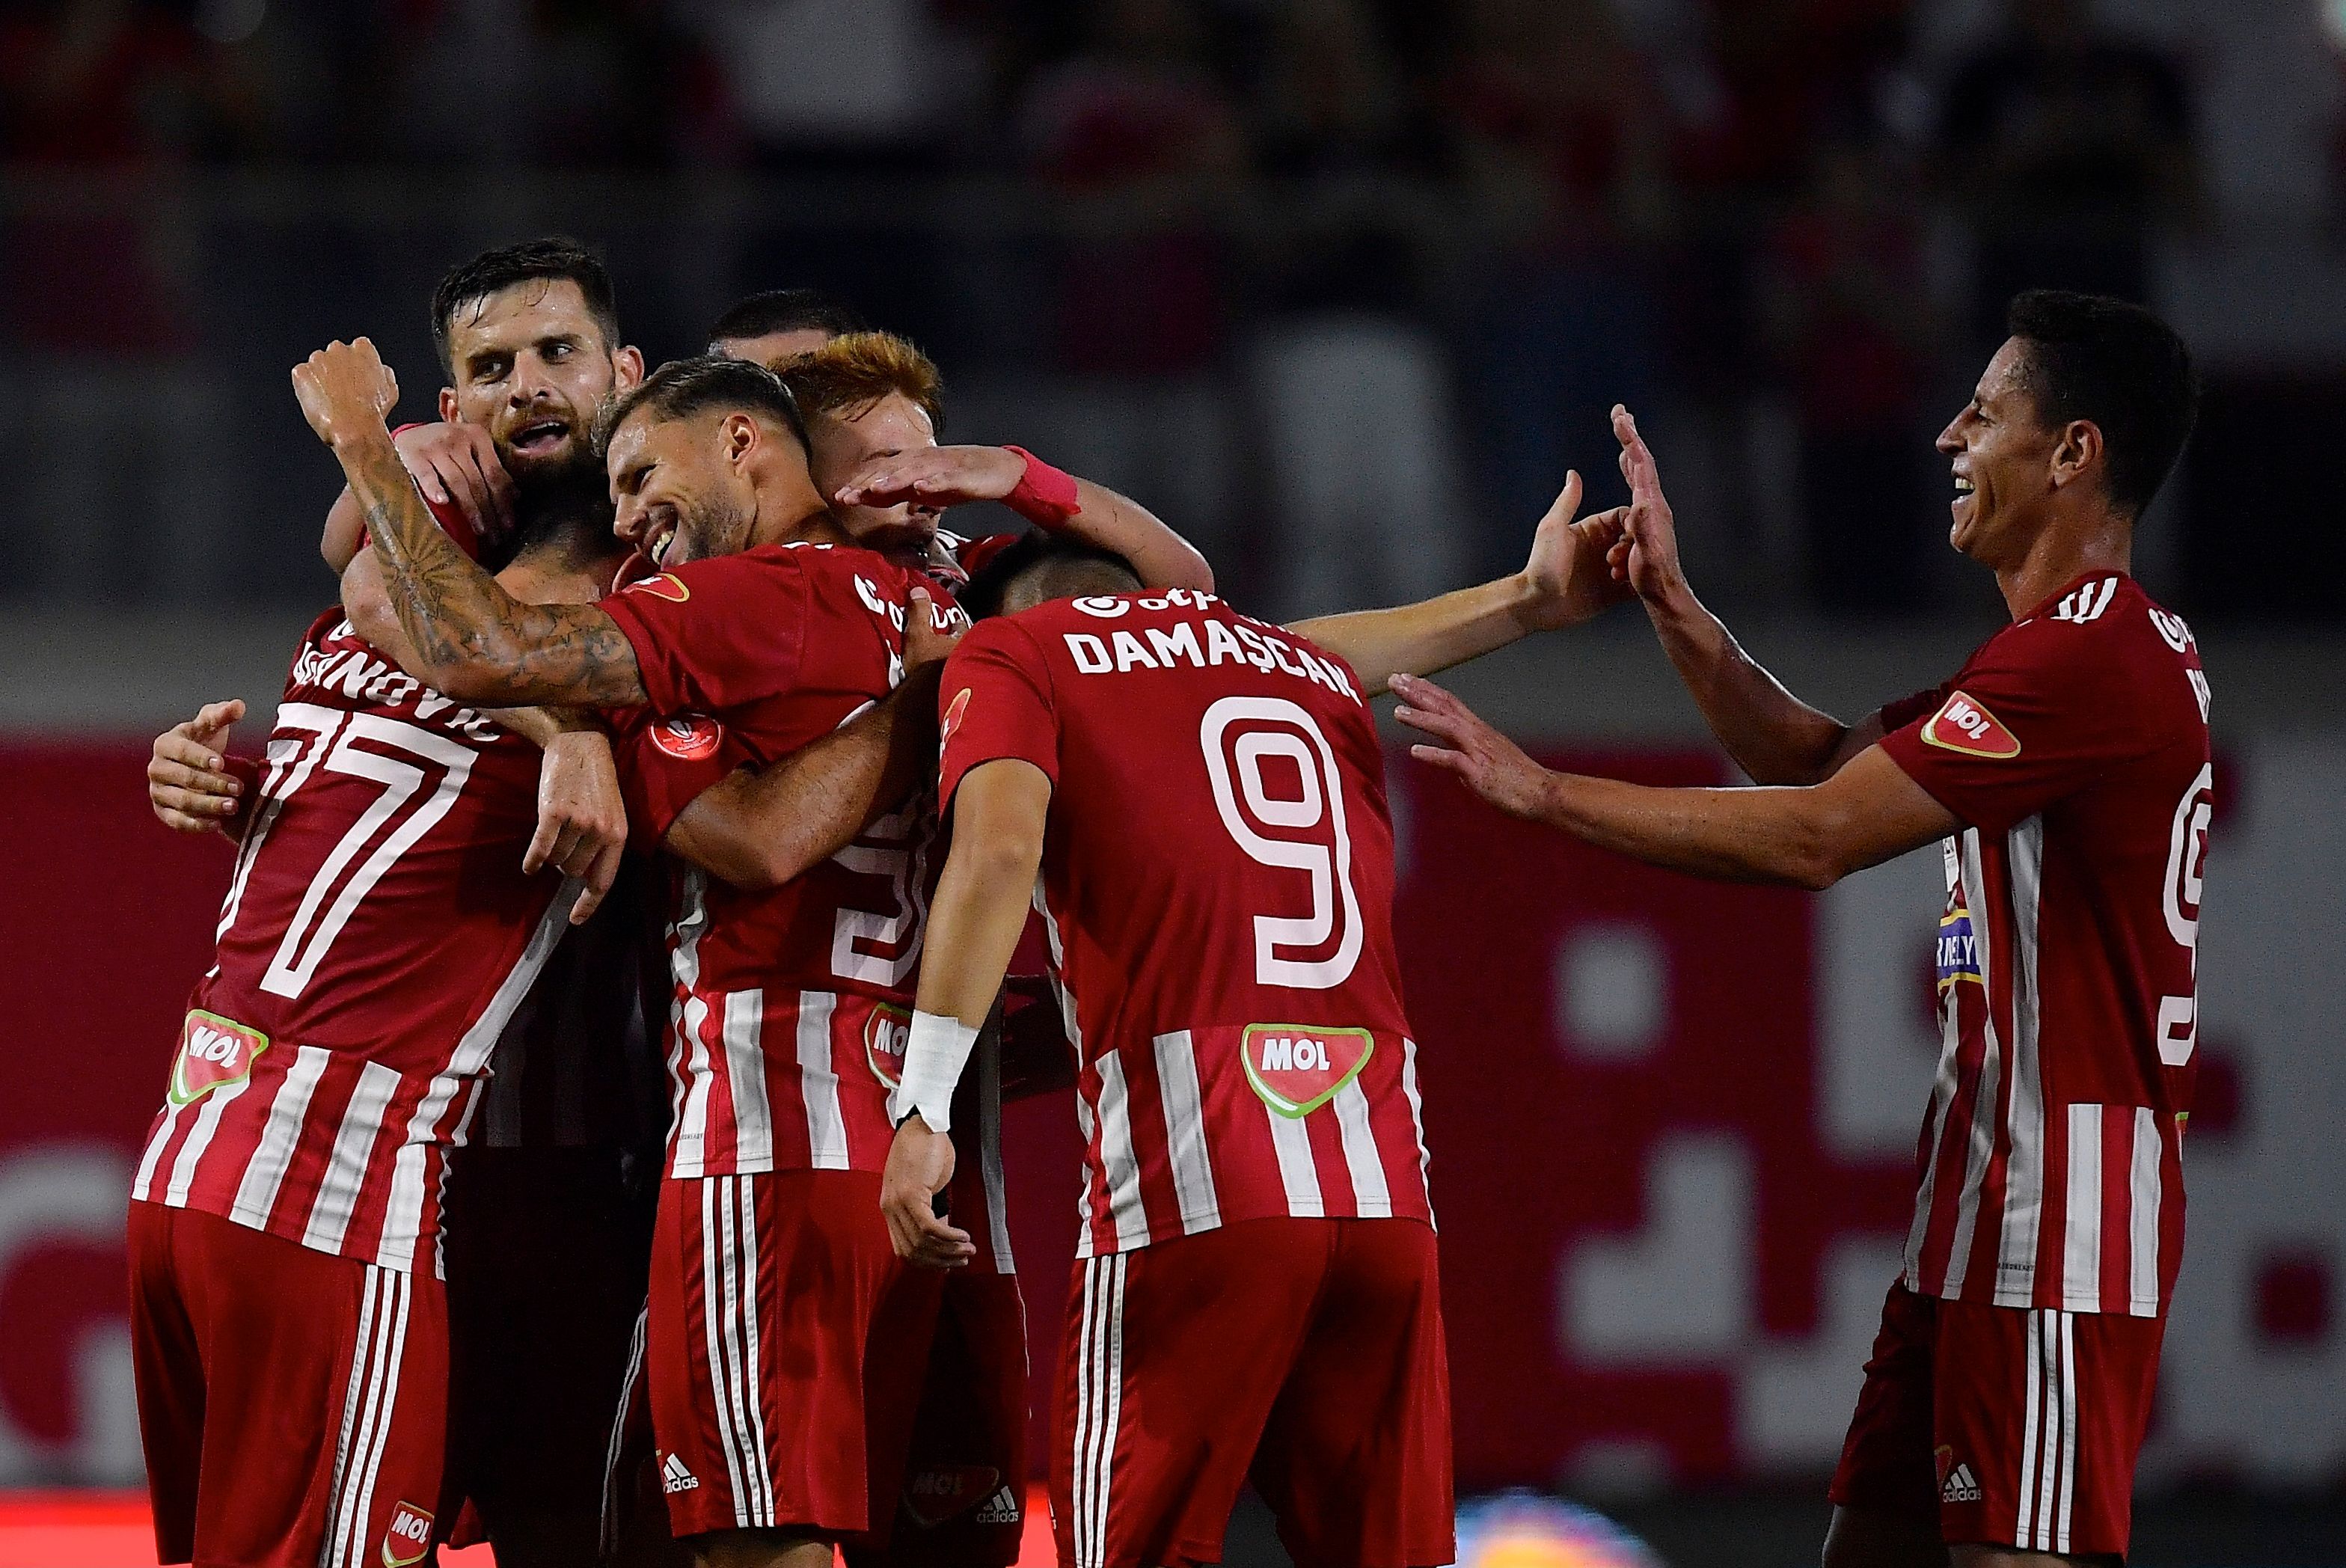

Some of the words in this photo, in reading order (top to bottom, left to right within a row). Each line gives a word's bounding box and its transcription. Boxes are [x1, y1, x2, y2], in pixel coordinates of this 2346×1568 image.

[1944, 700, 1991, 740] MOL
[207, 701, 480, 999] 77
[1200, 696, 1364, 989] 9
[189, 1025, 242, 1069] MOL
[873, 1017, 909, 1057] MO
[1261, 1038, 1331, 1071] MOL
[663, 1476, 699, 1494] didas
[1942, 1486, 1982, 1503] adidas
[391, 1510, 430, 1545] MOL
[976, 1509, 1020, 1524] adidas
